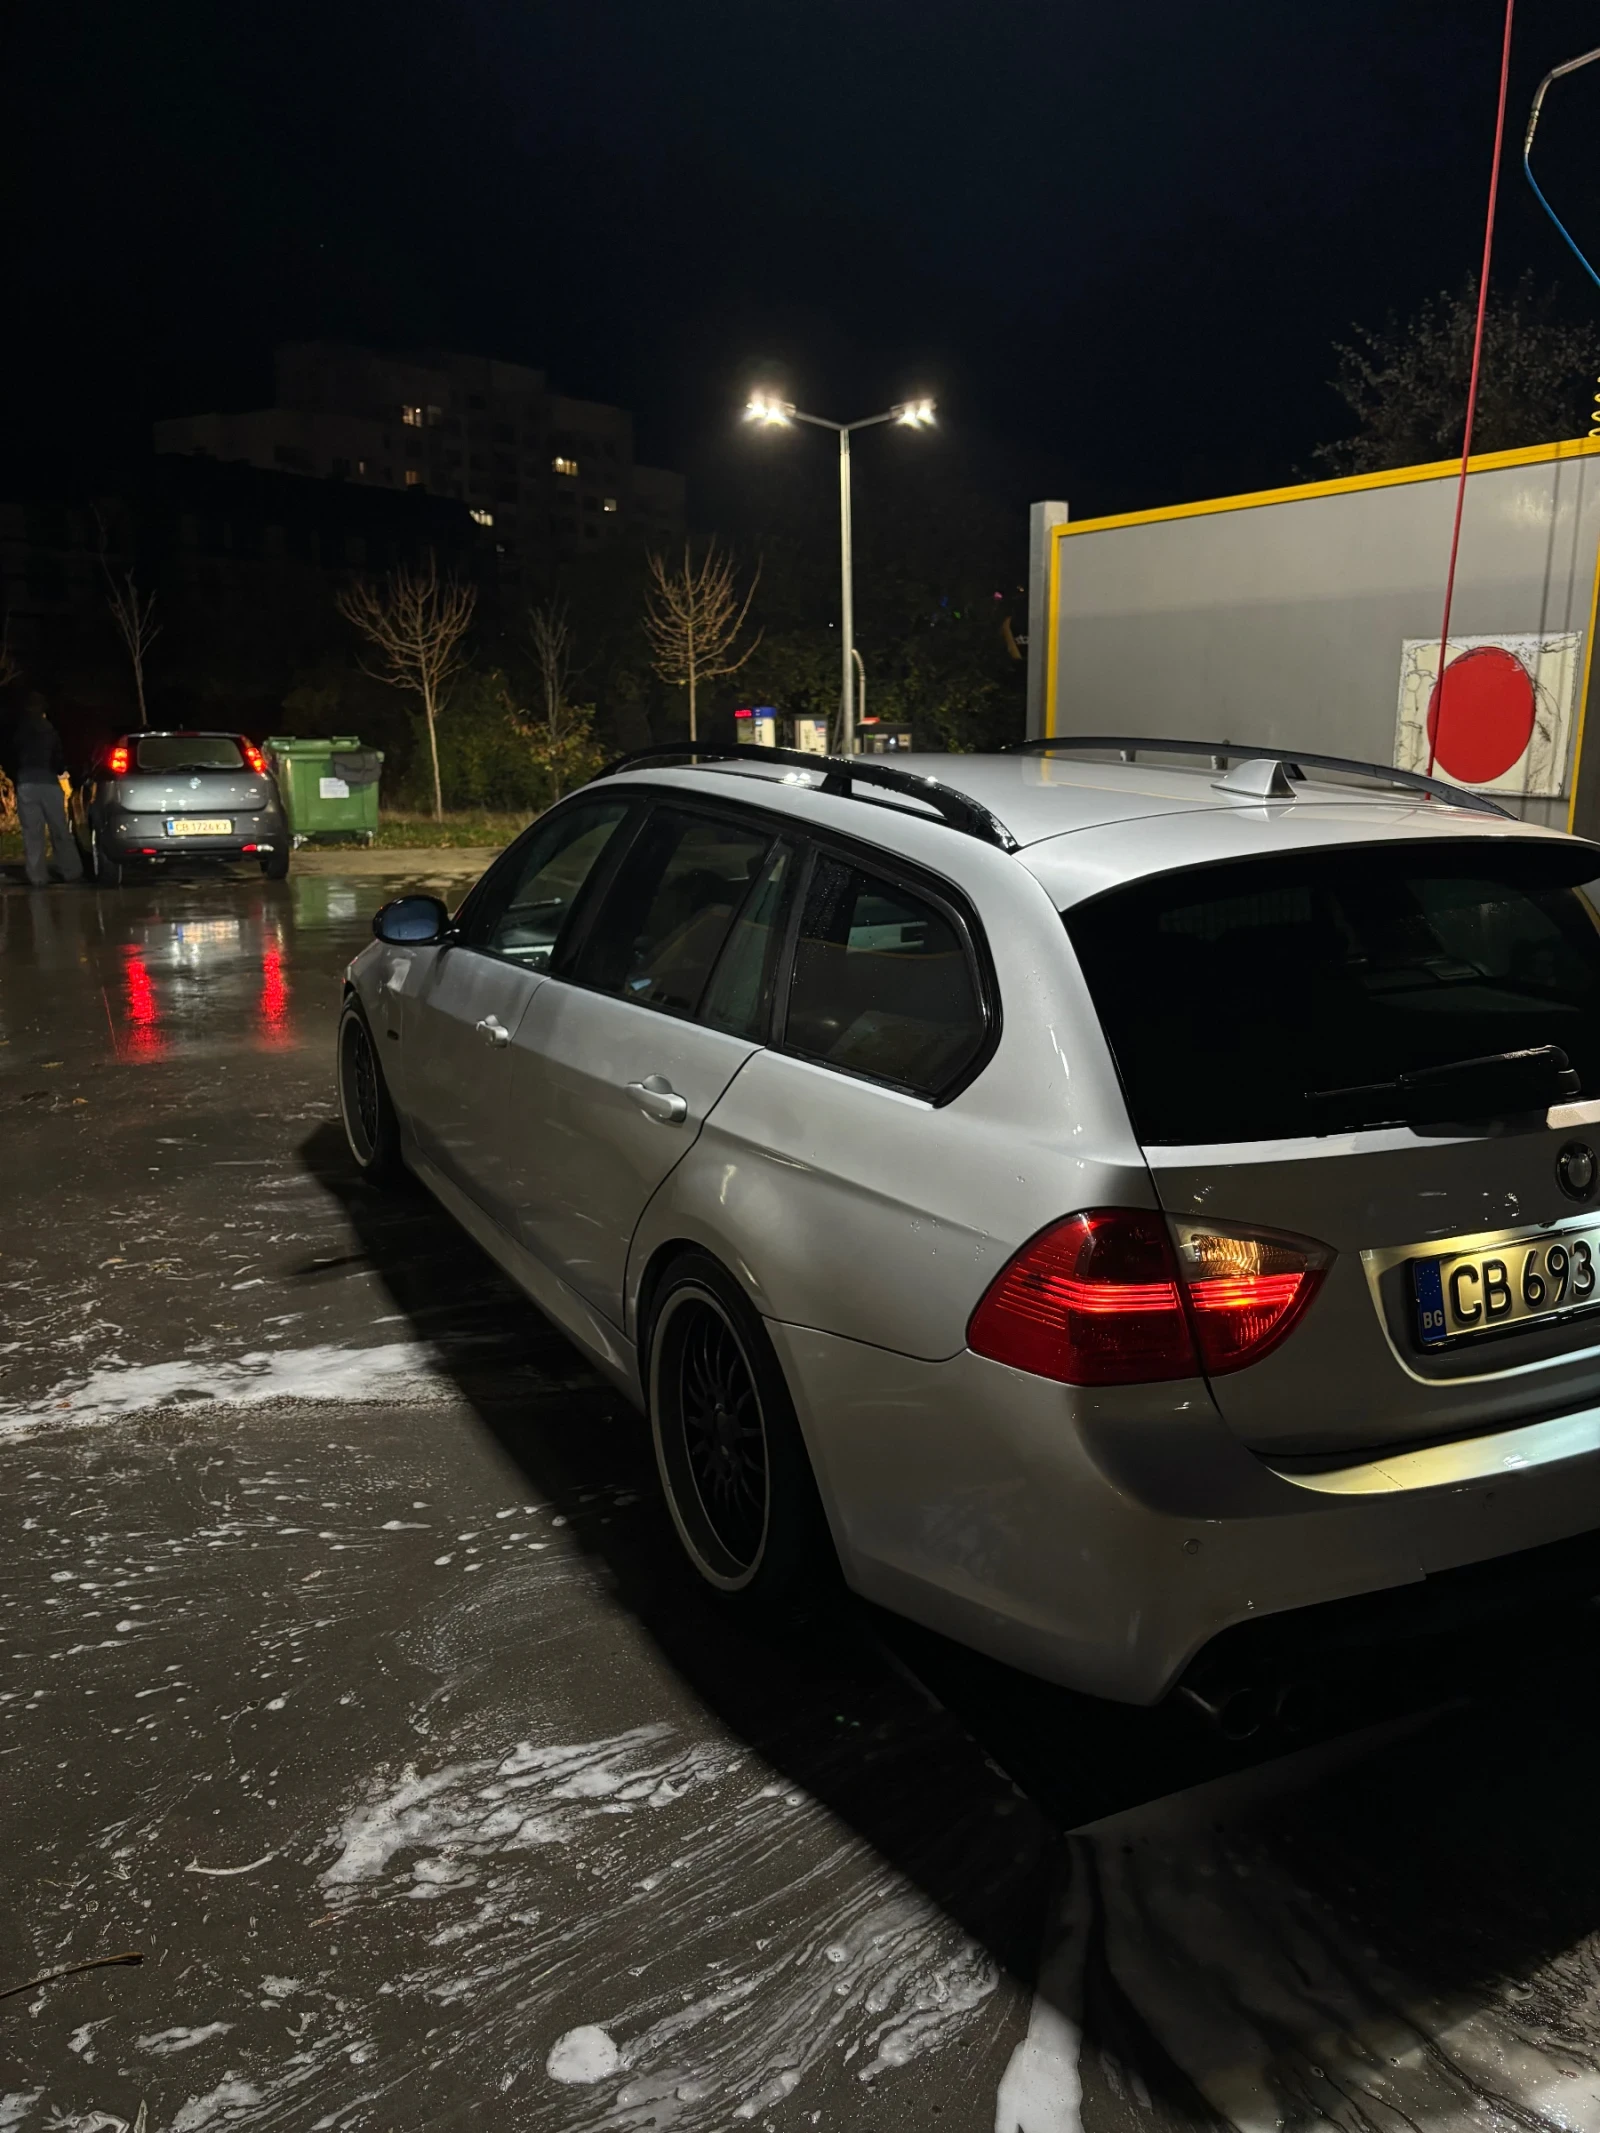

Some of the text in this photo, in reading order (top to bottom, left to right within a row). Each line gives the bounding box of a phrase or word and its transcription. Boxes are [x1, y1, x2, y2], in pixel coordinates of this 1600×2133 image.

[1449, 1238, 1600, 1324] CB 693
[1423, 1309, 1443, 1330] BG
